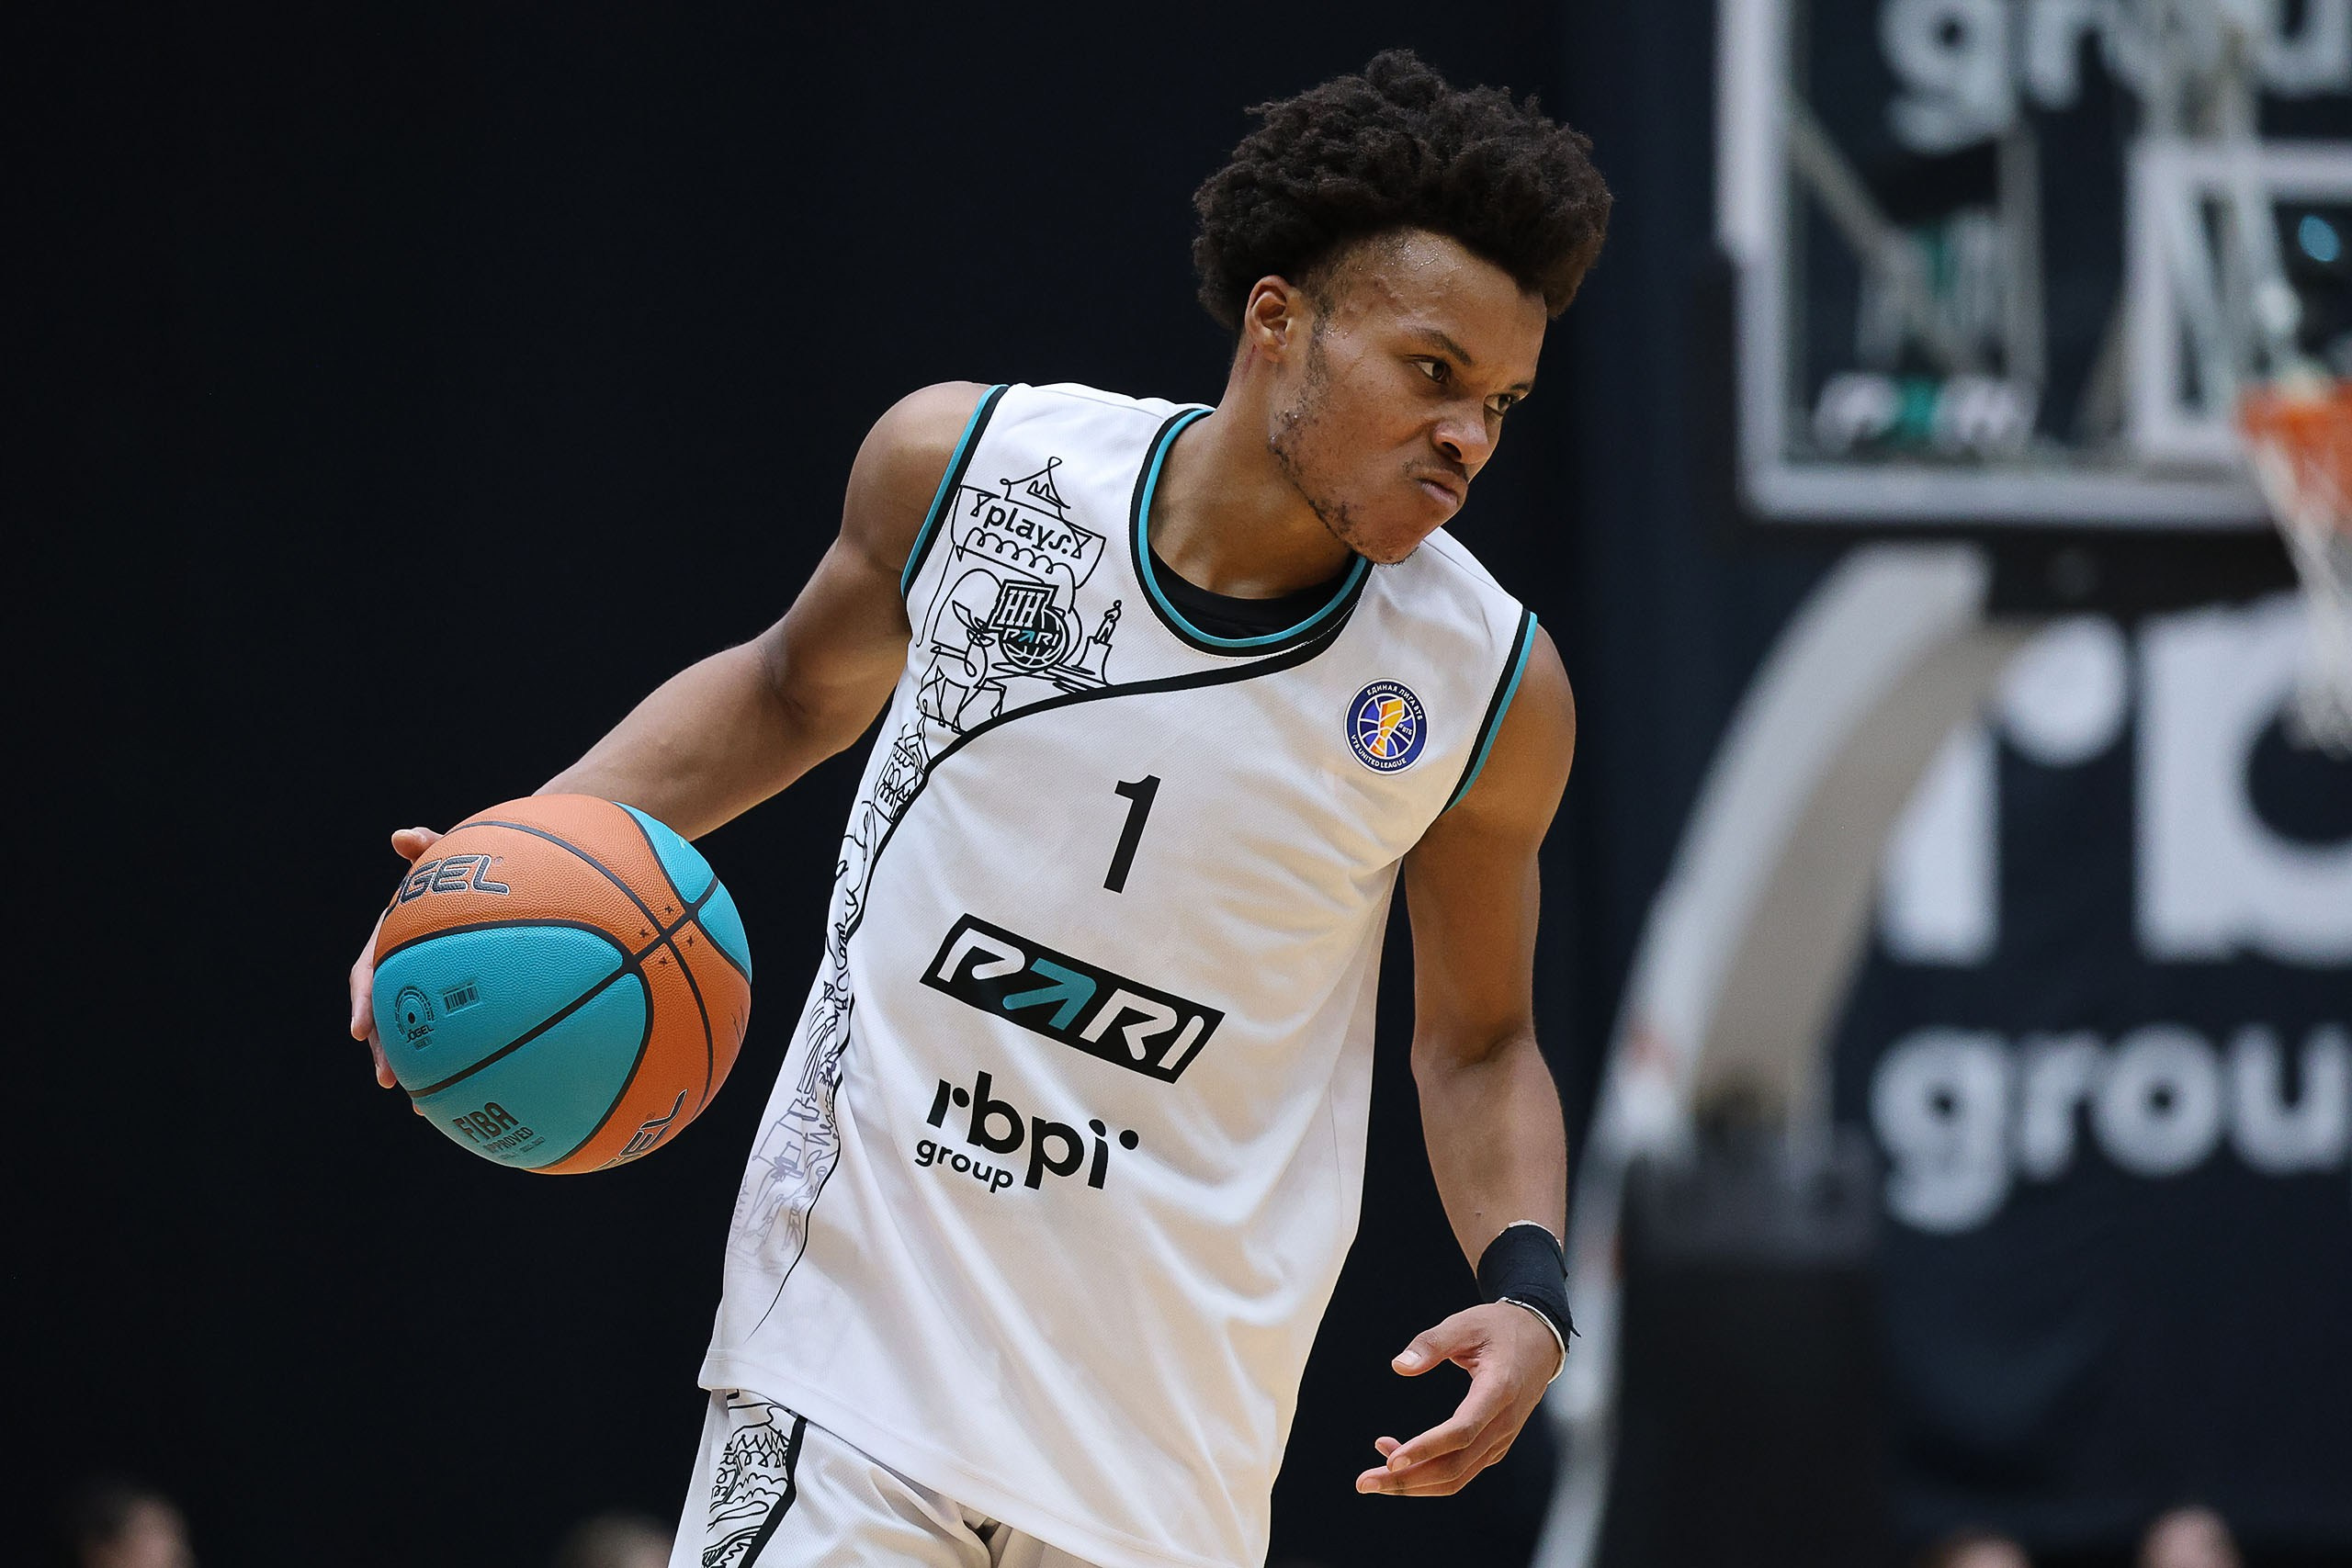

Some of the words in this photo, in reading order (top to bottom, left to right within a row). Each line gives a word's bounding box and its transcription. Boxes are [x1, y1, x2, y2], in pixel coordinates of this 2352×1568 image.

[1366, 684, 1398, 696] ЕДИНАЯ
[1398, 689, 1416, 707] ЛИГА
[1413, 705, 1423, 721] ВТБ
[1351, 734, 1360, 750] VTB
[1358, 748, 1380, 767] UNITED
[1380, 757, 1408, 769] LEAGUE
[1102, 774, 1161, 894] 1
[398, 854, 511, 904] GEL
[936, 927, 1205, 1071] PARI
[452, 1101, 520, 1144] FIBA
[915, 1139, 1014, 1193] group
